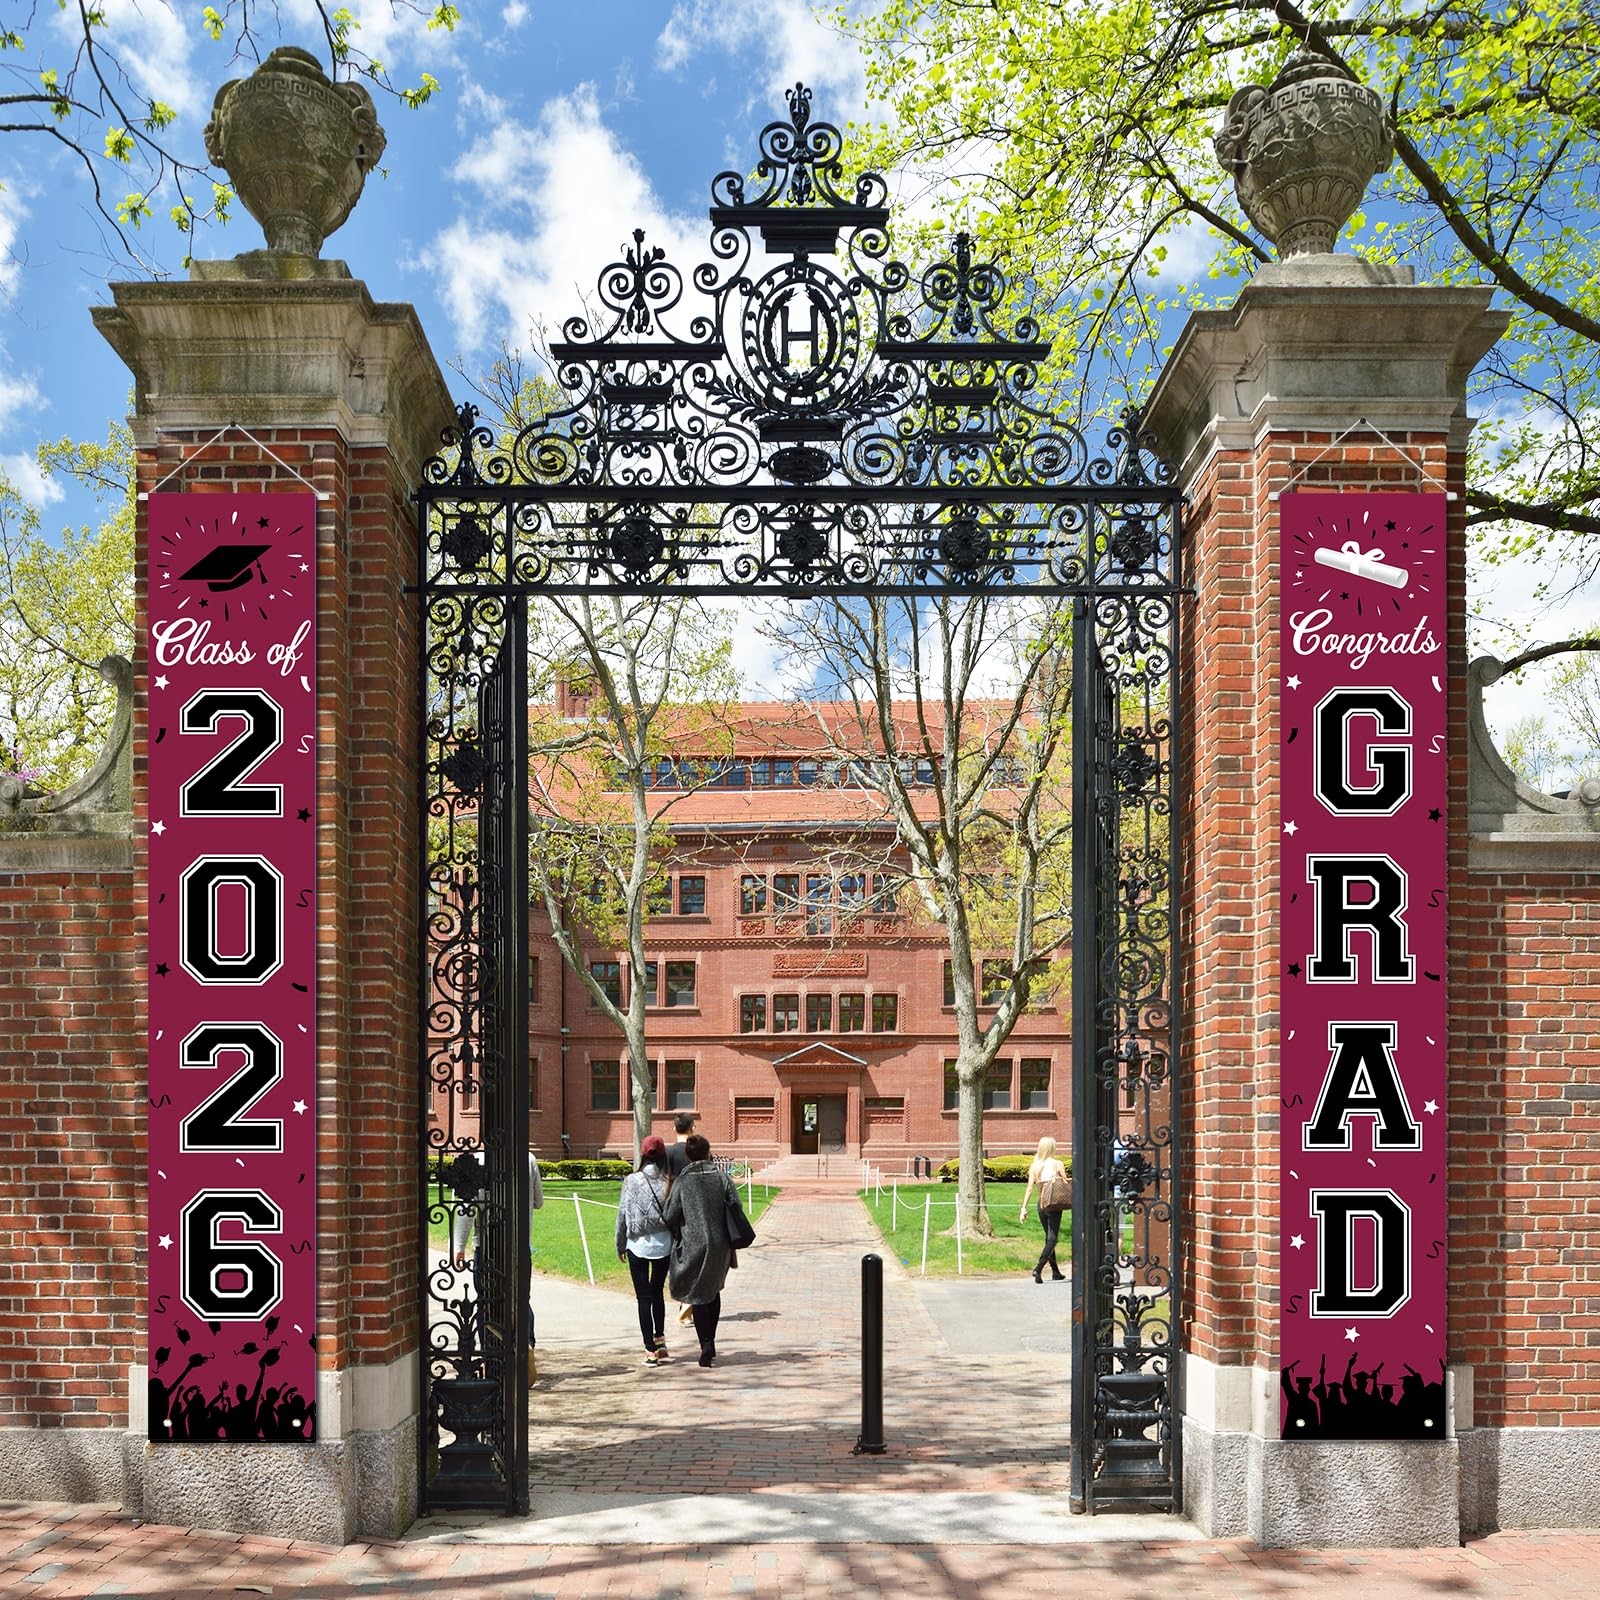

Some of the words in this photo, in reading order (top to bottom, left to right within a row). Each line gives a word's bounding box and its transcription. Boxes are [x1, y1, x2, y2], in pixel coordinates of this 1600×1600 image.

[780, 305, 819, 367] H
[151, 617, 256, 667] Class
[266, 619, 312, 677] of
[1289, 608, 1442, 671] Congrats
[179, 688, 284, 1322] 2026
[1302, 686, 1423, 1319] GRAD
